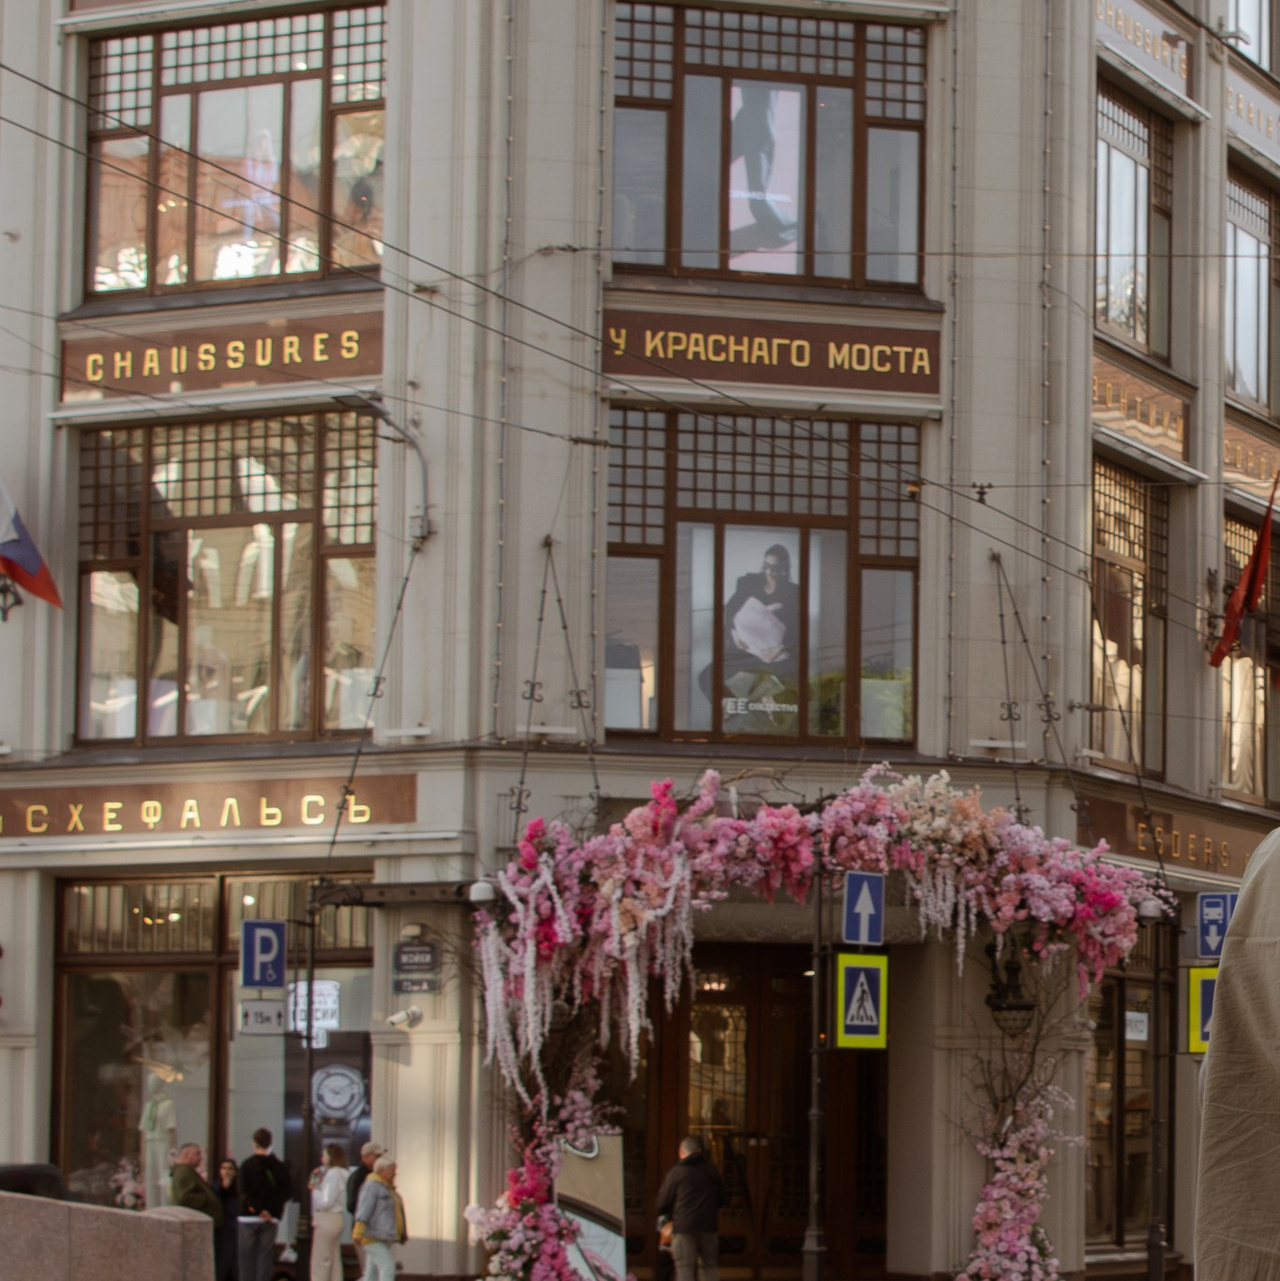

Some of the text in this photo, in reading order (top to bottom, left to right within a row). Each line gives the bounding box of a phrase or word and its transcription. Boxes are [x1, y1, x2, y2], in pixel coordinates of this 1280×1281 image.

[85, 329, 362, 383] CHAUSSURES
[608, 326, 932, 376] У КРАСНАГО МОСТА
[25, 793, 373, 834] СХЕФАЛЬСЪ
[1136, 822, 1230, 868] ESDERS
